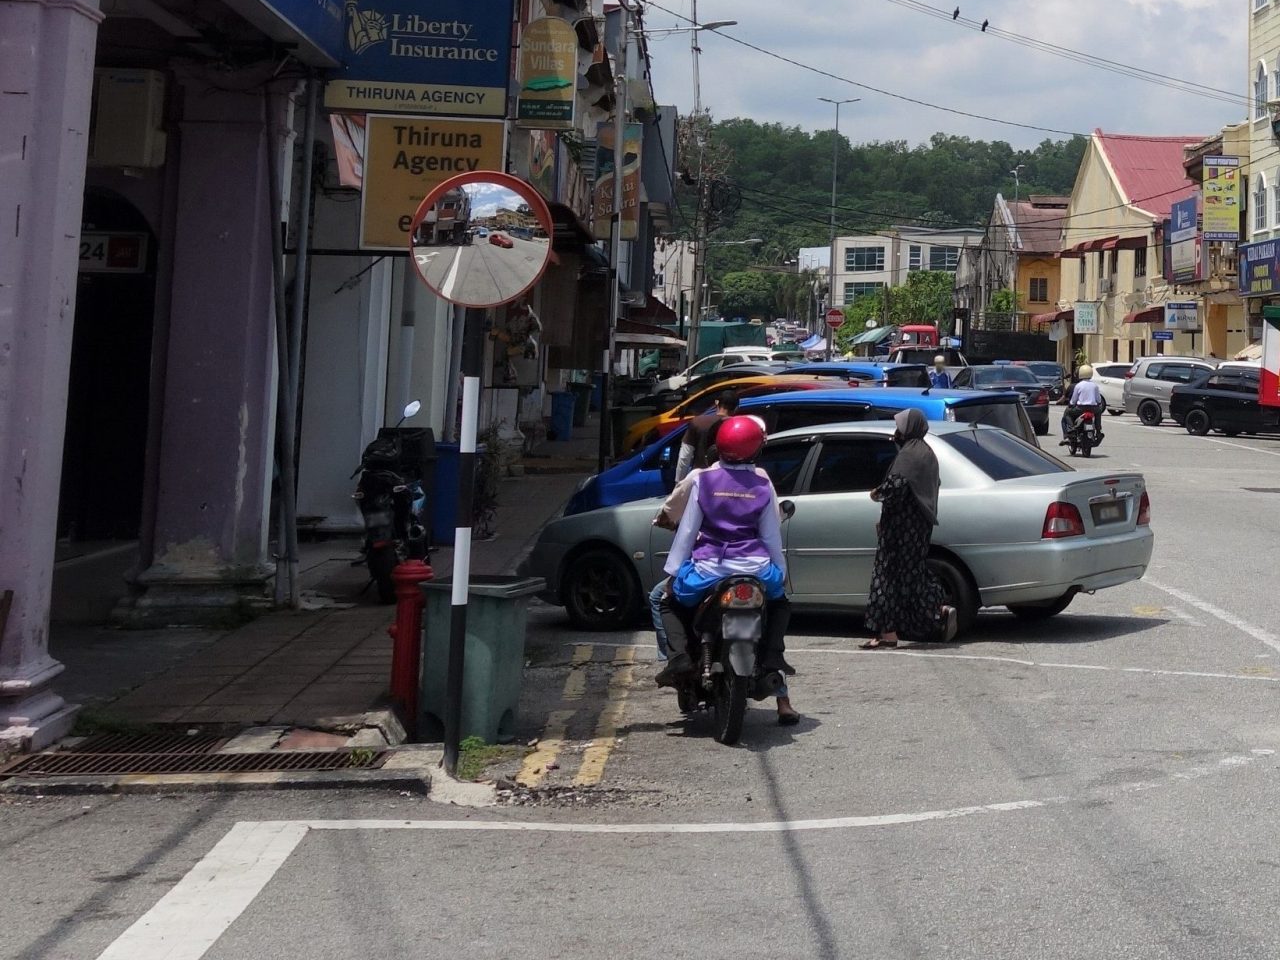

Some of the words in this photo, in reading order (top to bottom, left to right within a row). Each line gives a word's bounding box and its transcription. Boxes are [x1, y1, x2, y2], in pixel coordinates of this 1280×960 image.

[391, 14, 473, 41] Liberty
[390, 39, 498, 62] Insurance
[530, 55, 565, 70] Villas
[347, 86, 416, 101] THIRUNA
[421, 90, 485, 104] AGENCY
[393, 126, 482, 148] Thiruna
[393, 150, 480, 175] Agency
[80, 242, 104, 260] 24
